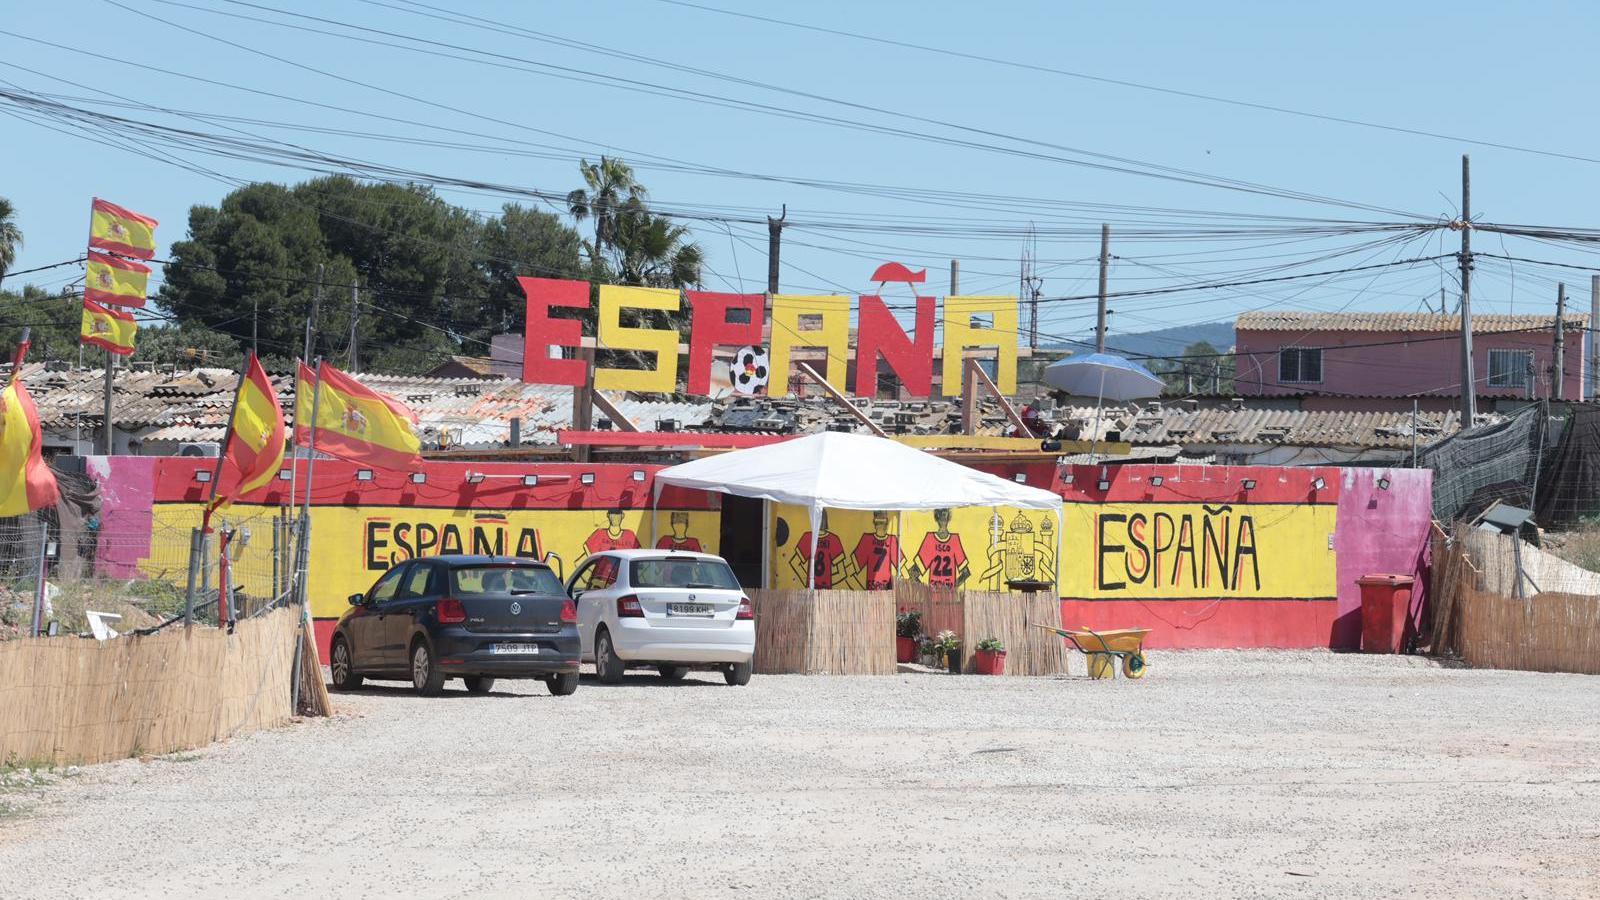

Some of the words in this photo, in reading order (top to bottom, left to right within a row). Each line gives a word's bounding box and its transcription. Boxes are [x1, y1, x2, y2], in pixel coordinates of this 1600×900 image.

[516, 261, 1019, 398] ESPAÑA
[935, 544, 951, 552] ISCO
[1096, 504, 1261, 591] ESPAÑA
[873, 547, 888, 572] 7
[933, 555, 953, 576] 22
[495, 643, 518, 653] 7509
